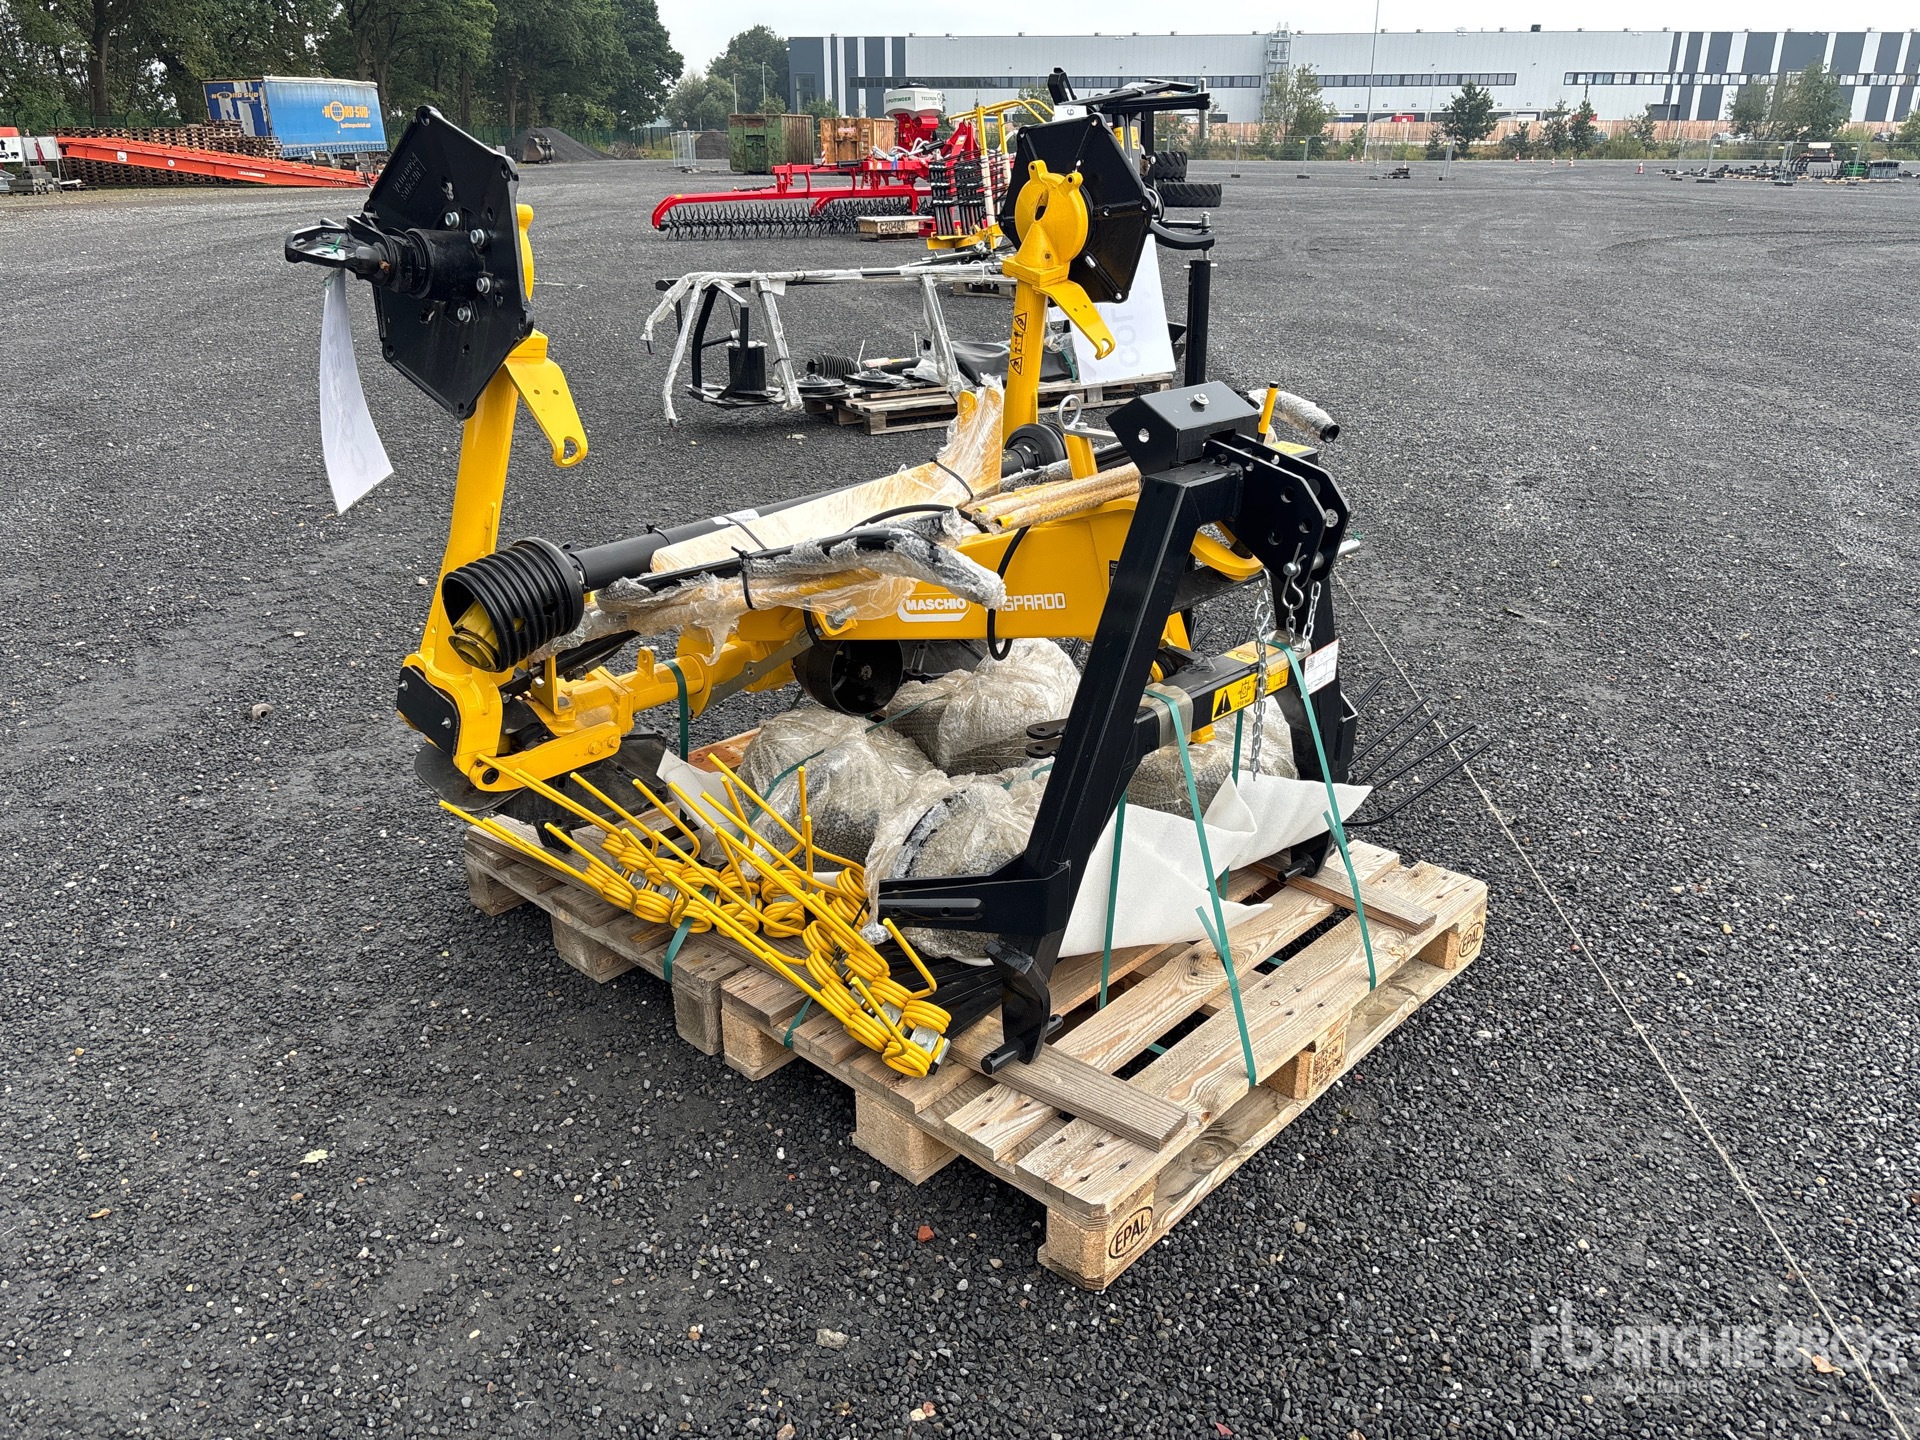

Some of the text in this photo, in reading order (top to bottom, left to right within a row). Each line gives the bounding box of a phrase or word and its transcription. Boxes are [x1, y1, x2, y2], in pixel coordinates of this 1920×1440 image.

[905, 597, 967, 611] MASCHIO
[985, 592, 1067, 613] SPARDO
[1462, 926, 1480, 954] EPAL
[1115, 1214, 1148, 1255] EPAL
